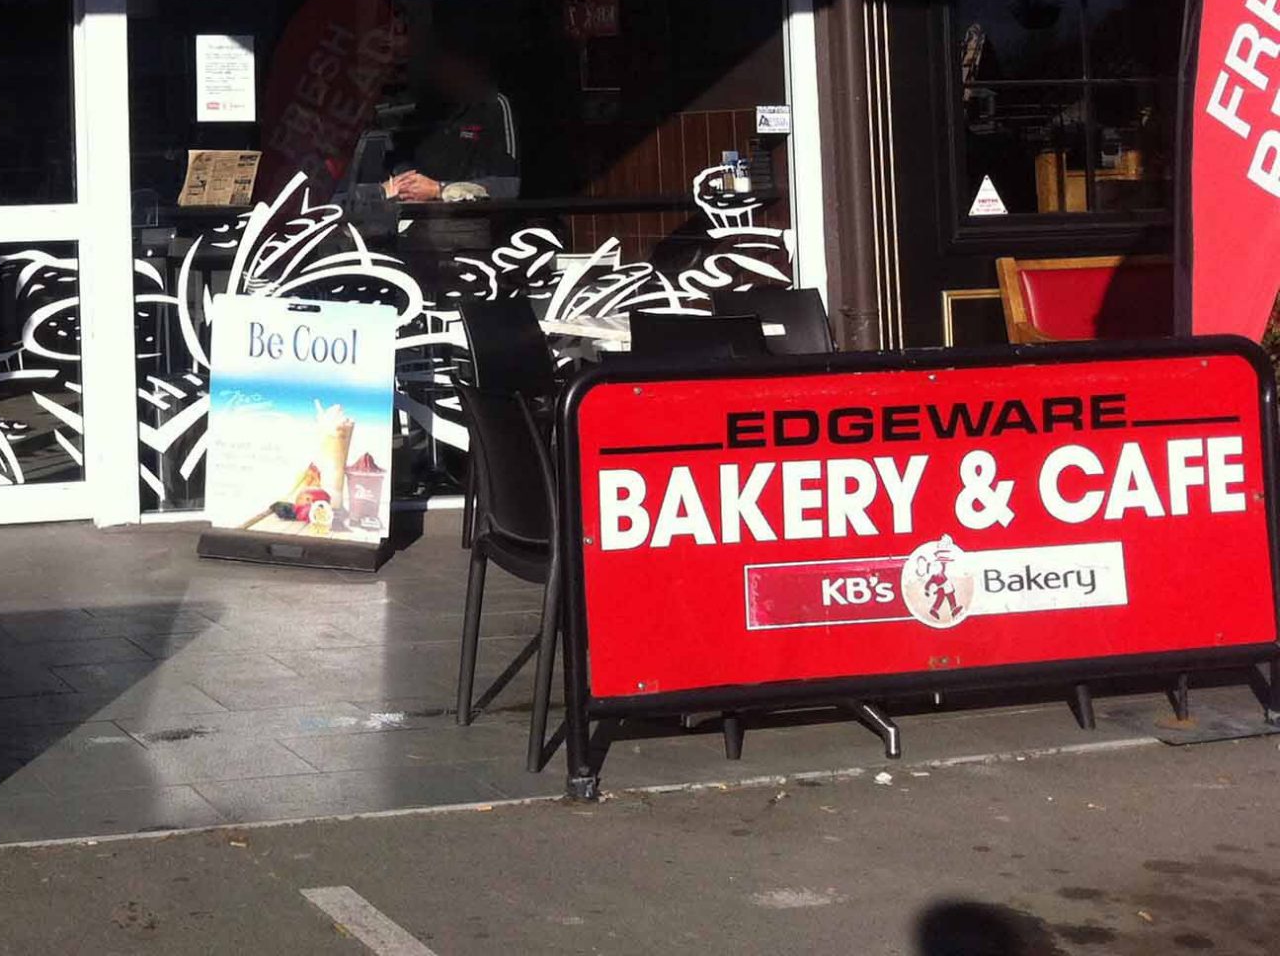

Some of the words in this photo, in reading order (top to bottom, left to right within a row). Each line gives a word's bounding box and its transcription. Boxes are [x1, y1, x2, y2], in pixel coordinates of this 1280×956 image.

[249, 322, 284, 360] Be
[293, 324, 358, 365] Cool
[725, 393, 1127, 449] EDGEWARE
[598, 454, 929, 551] BAKERY
[954, 449, 1016, 530] &
[1038, 435, 1247, 525] CAFE
[821, 575, 895, 607] KB's
[982, 564, 1097, 595] Bakery
